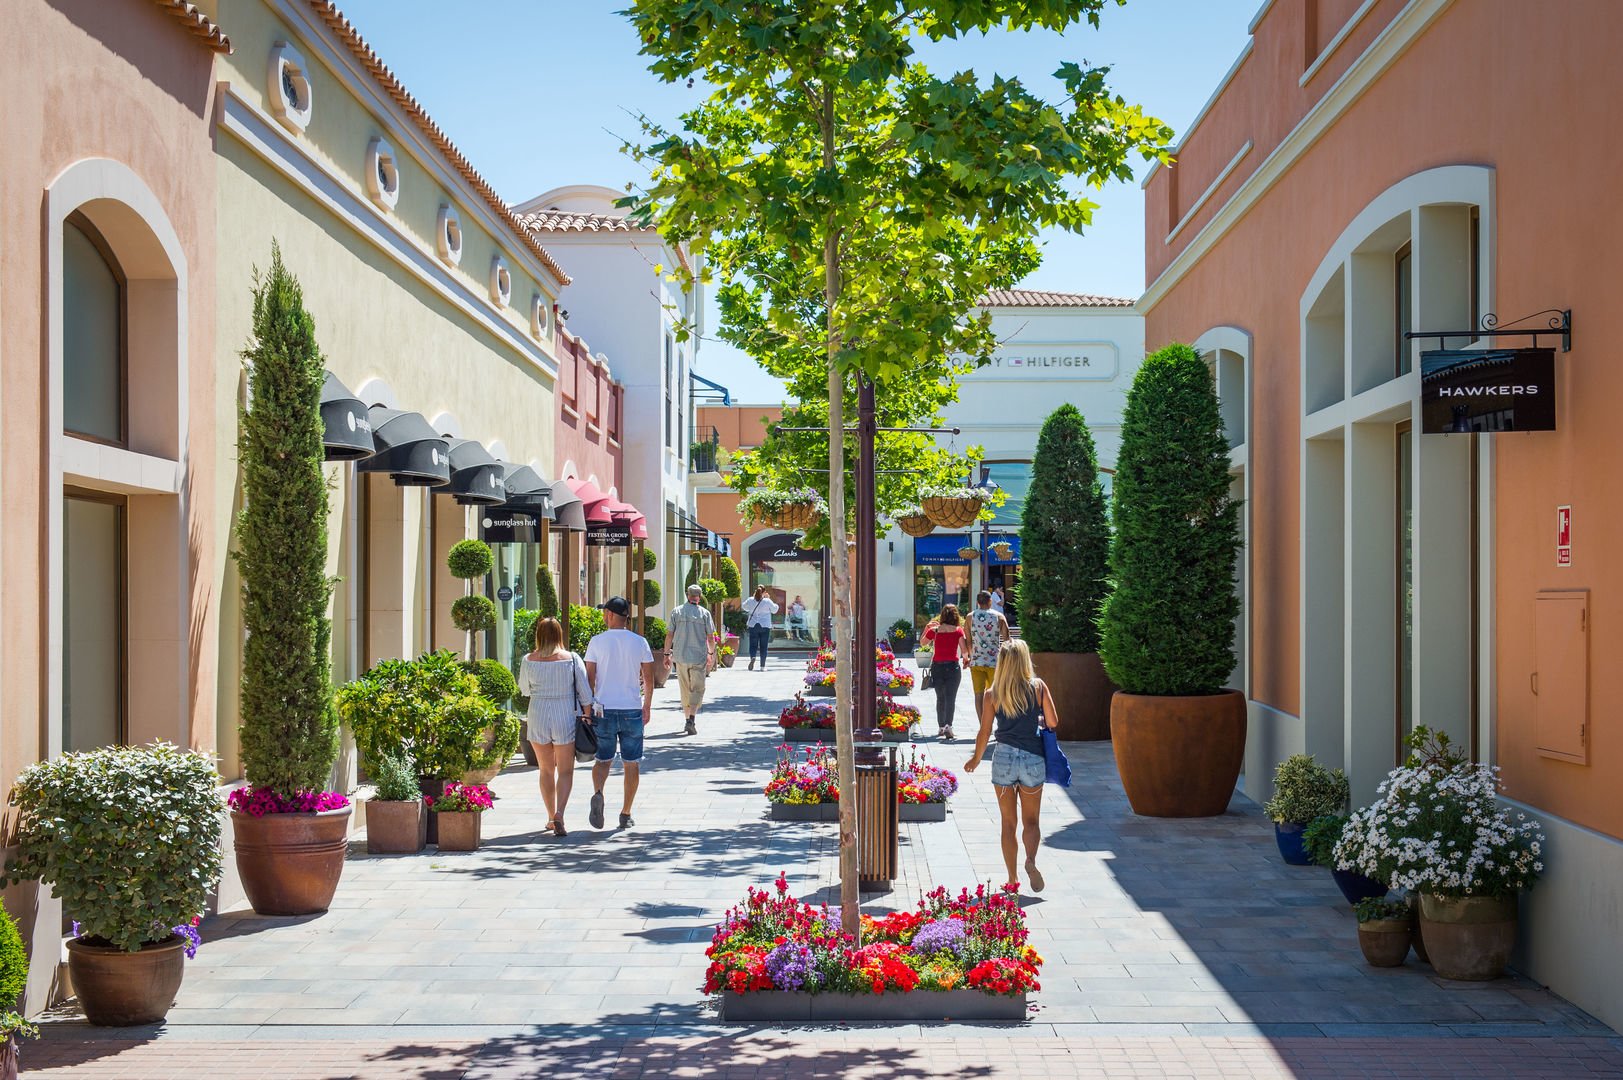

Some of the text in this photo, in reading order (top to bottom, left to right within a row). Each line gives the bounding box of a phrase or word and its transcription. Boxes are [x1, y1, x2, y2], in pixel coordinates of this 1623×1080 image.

[1027, 356, 1090, 367] HILFIGER
[1439, 385, 1538, 397] HAWKERS
[493, 518, 537, 528] sunglass hut
[773, 549, 798, 557] Clarks
